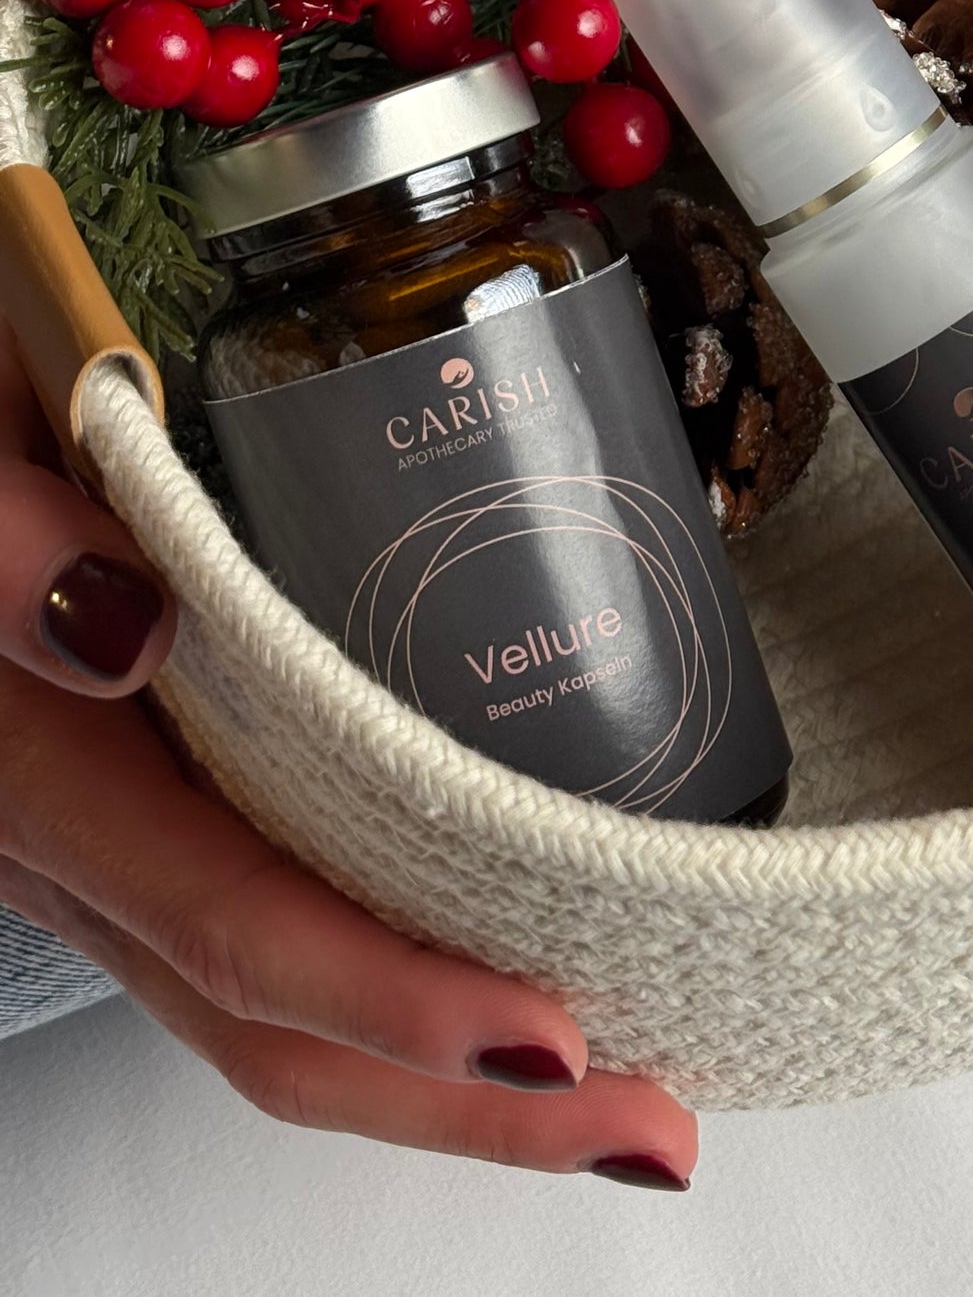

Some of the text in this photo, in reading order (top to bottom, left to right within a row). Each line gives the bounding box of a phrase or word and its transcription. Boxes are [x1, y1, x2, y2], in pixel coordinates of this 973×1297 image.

[386, 365, 550, 450] CARISH
[397, 427, 494, 472] APOTHECARY
[463, 606, 624, 685] Vellure
[485, 654, 634, 722] Beauty Kapseln
